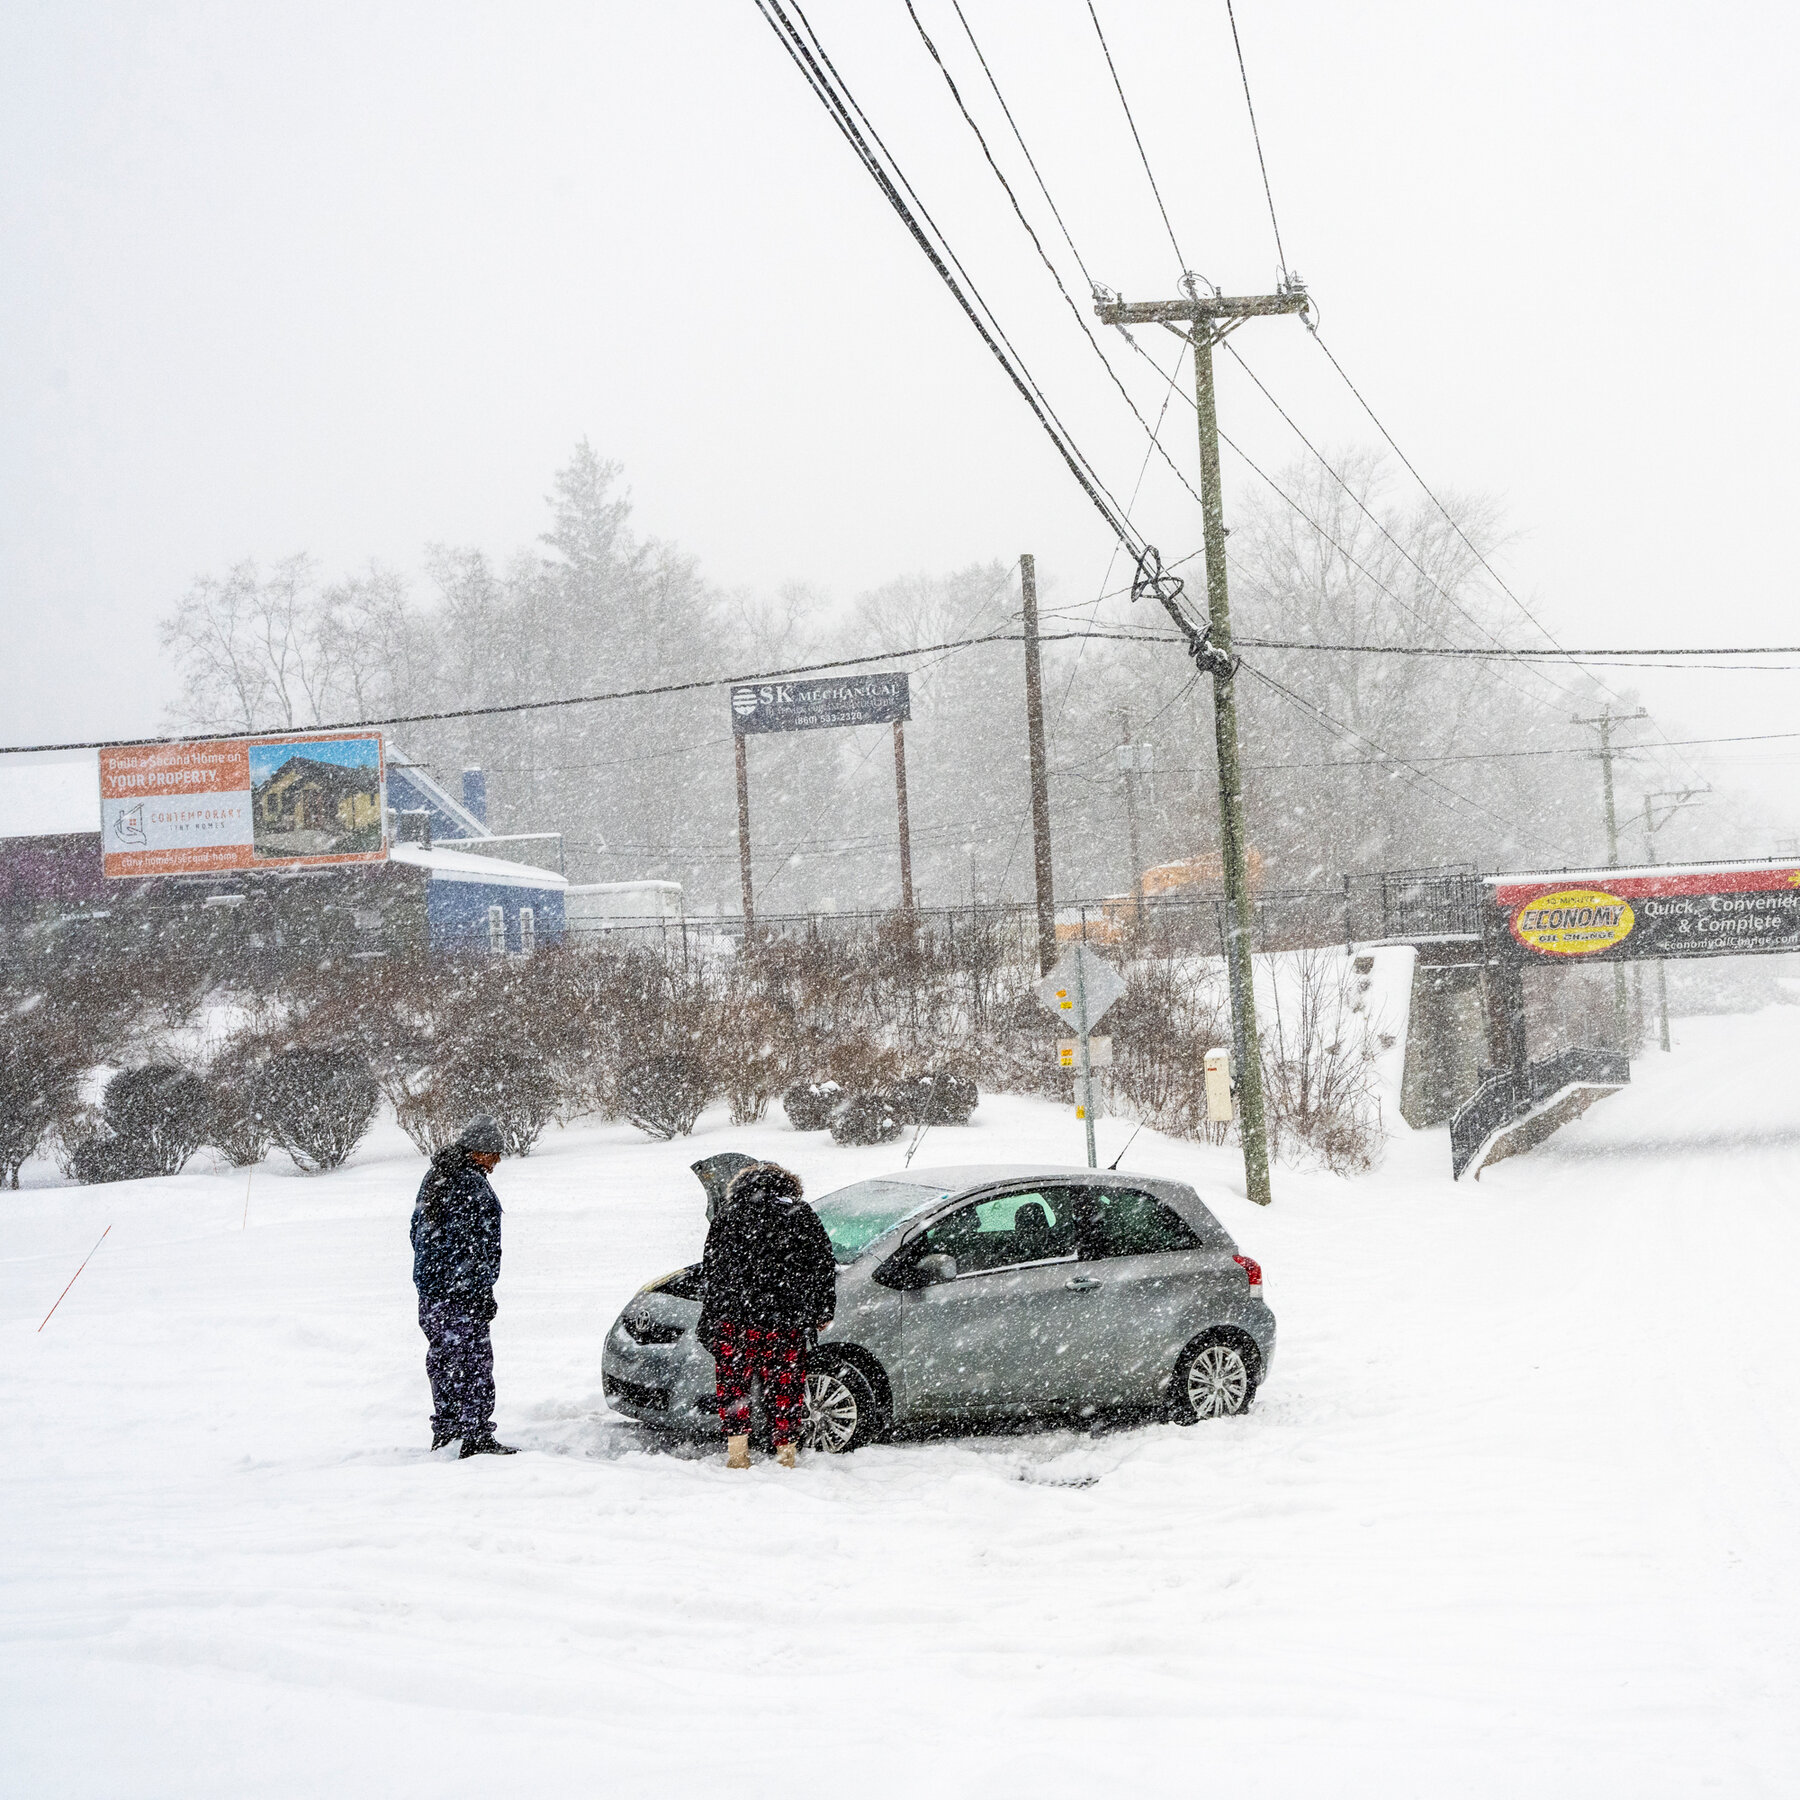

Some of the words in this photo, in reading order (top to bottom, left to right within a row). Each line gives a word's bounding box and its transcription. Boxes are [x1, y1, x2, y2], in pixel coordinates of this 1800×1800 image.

[760, 684, 793, 705] SK
[799, 683, 900, 702] MECHANICAL
[109, 758, 138, 770] Build
[140, 758, 147, 768] a
[149, 755, 190, 768] Second
[193, 752, 225, 764] Home
[227, 751, 241, 763] on
[109, 774, 146, 788] YOUR
[151, 809, 241, 823] CONTEMPORARY
[1521, 904, 1625, 931] ECONOMY
[1678, 918, 1691, 933] &
[1697, 914, 1782, 933] Complete
[1538, 934, 1559, 943] OIL
[1562, 930, 1615, 941] CHANGE
[1664, 935, 1798, 950] EconomyOilChange.com
